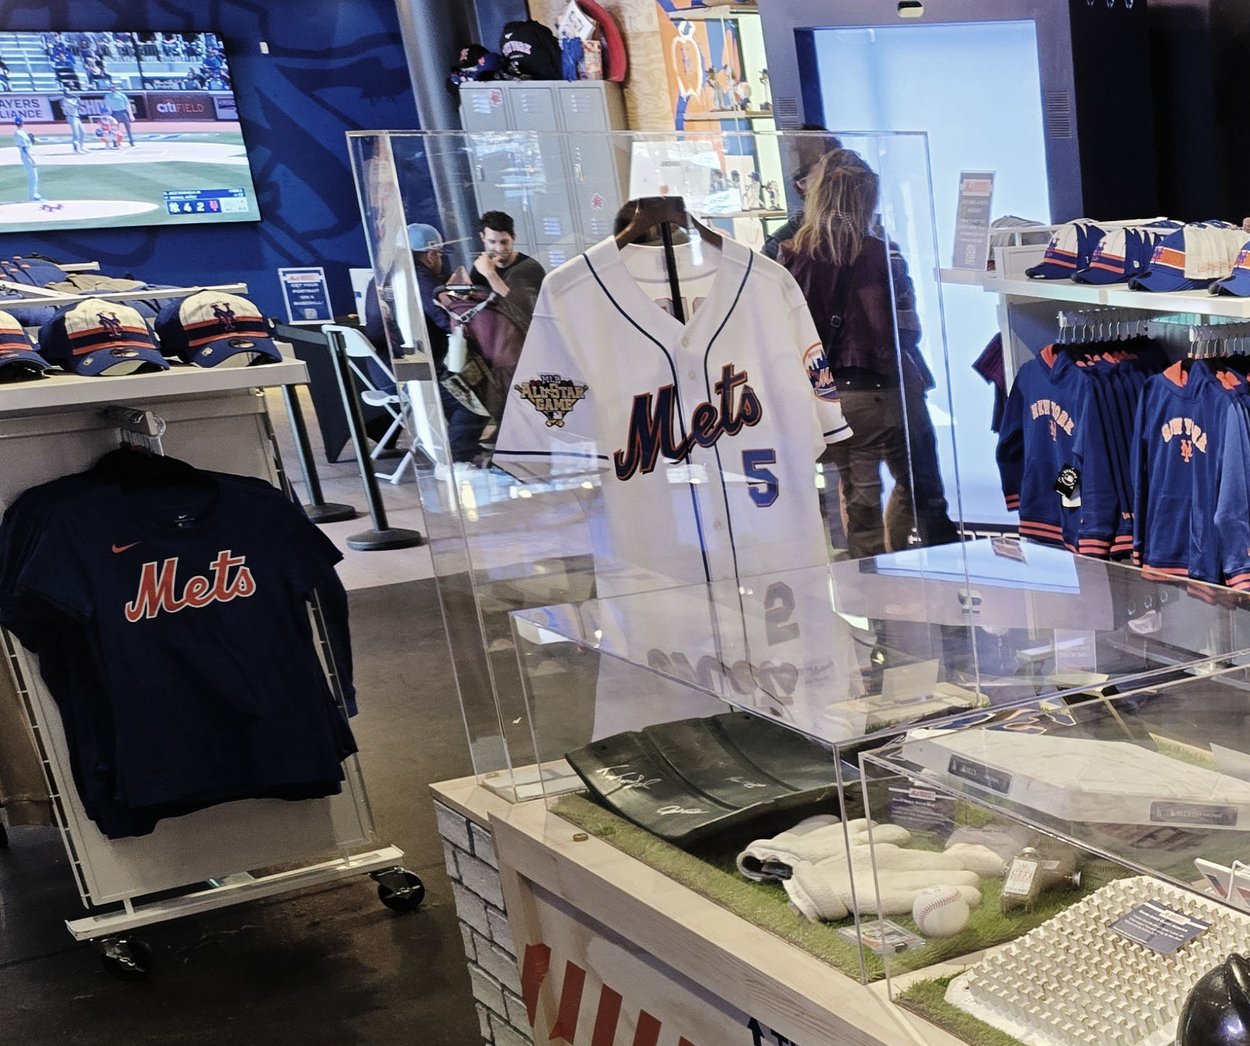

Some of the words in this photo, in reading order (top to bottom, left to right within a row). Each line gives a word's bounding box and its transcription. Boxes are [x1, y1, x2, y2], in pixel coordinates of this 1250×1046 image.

[536, 399, 573, 411] GAME
[613, 362, 762, 481] Mets
[742, 448, 779, 507] 5
[125, 550, 256, 622] Mets
